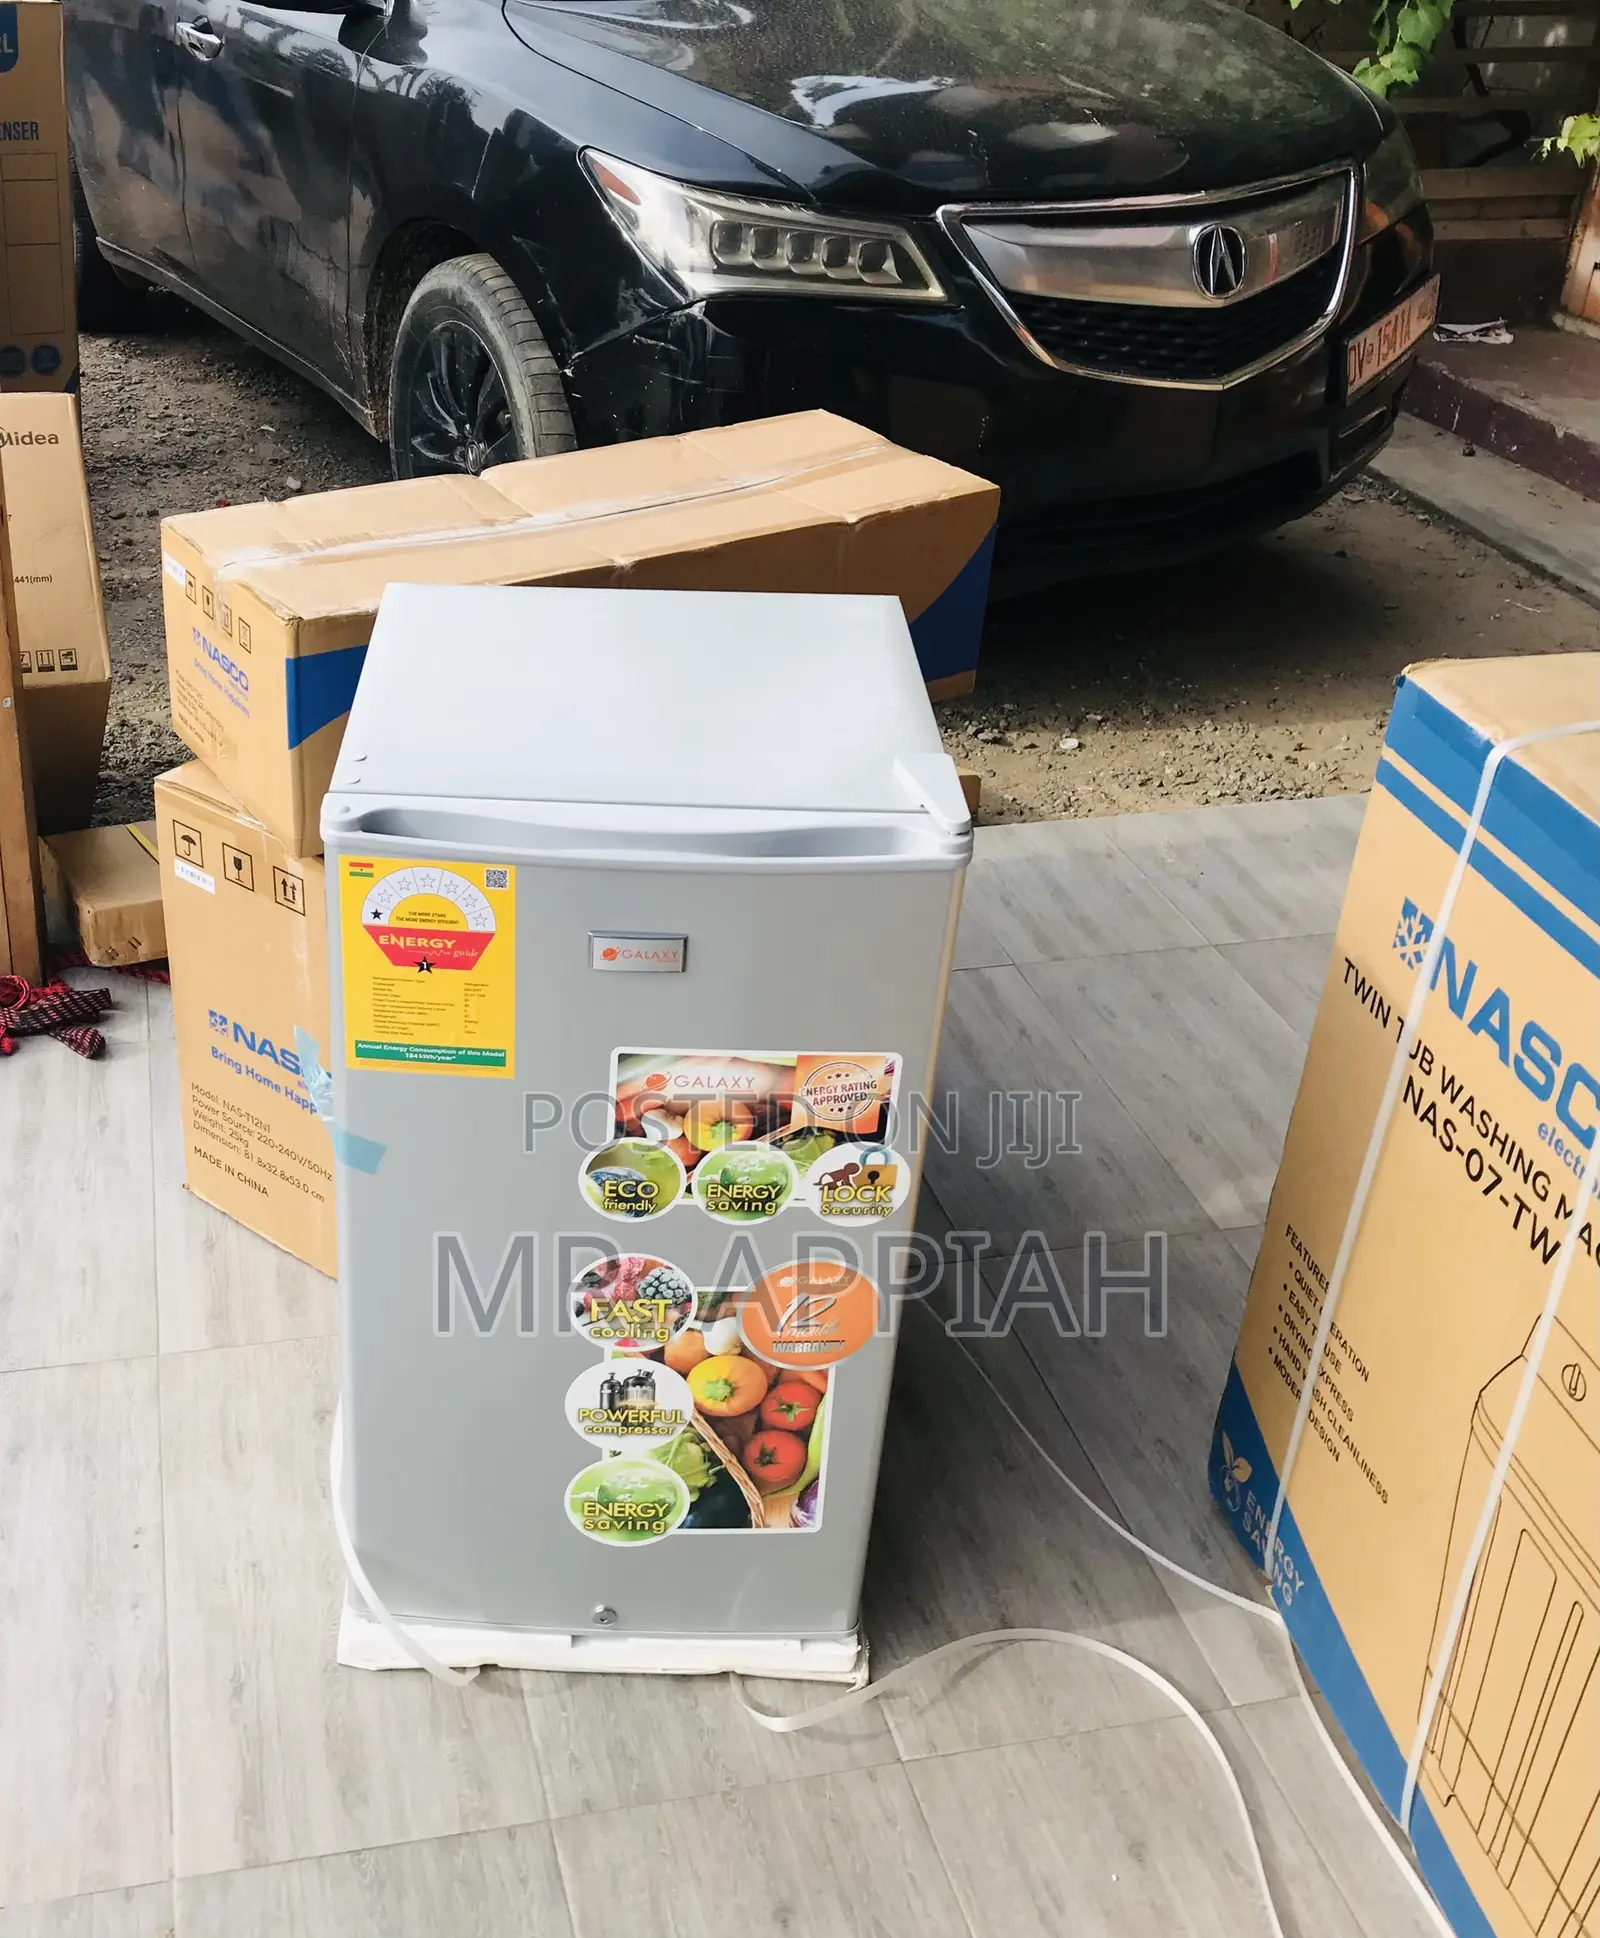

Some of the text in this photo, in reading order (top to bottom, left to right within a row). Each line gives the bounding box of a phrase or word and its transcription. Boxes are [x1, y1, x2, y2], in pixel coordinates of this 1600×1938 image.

[202, 636, 249, 692] NASCO
[379, 933, 457, 949] ENERGY
[452, 948, 479, 959] guide
[621, 948, 679, 961] GALAXY
[383, 1044, 408, 1053] Energy
[408, 1046, 457, 1056] Consumption
[211, 1046, 242, 1075] Bring
[245, 1066, 281, 1093] Home
[674, 1073, 755, 1089] GALAXY
[1344, 957, 1391, 1028] TWIN
[1441, 1065, 1551, 1202] WASHING
[801, 1080, 877, 1097] ENERGY RATING
[813, 1091, 868, 1107] APPROVED
[192, 1095, 220, 1117] Power
[221, 1111, 255, 1138] Source:
[229, 1128, 250, 1149] 25kg
[194, 1146, 269, 1198] MADE IN CHINA
[603, 1180, 660, 1199] ECO
[706, 1183, 781, 1199] ENERGY
[821, 1185, 892, 1203] LOCK
[603, 1198, 657, 1213] friendly
[706, 1199, 777, 1215] saving
[820, 1203, 892, 1217] Security
[1294, 1268, 1319, 1308] QUIET
[590, 1298, 673, 1324] FAST
[589, 1324, 671, 1343] cooling
[1288, 1291, 1311, 1326] EASY
[1324, 1342, 1343, 1375] USE
[772, 1340, 846, 1353] WARRANTY
[578, 1408, 687, 1425] POWERFUL
[1273, 1354, 1341, 1463] MODER DESIGN
[1278, 1333, 1302, 1372] HAND
[1327, 1409, 1389, 1504] CLEANLINESS
[584, 1423, 677, 1437] compressor
[582, 1501, 670, 1518] ENERGY
[583, 1518, 666, 1534] saving
